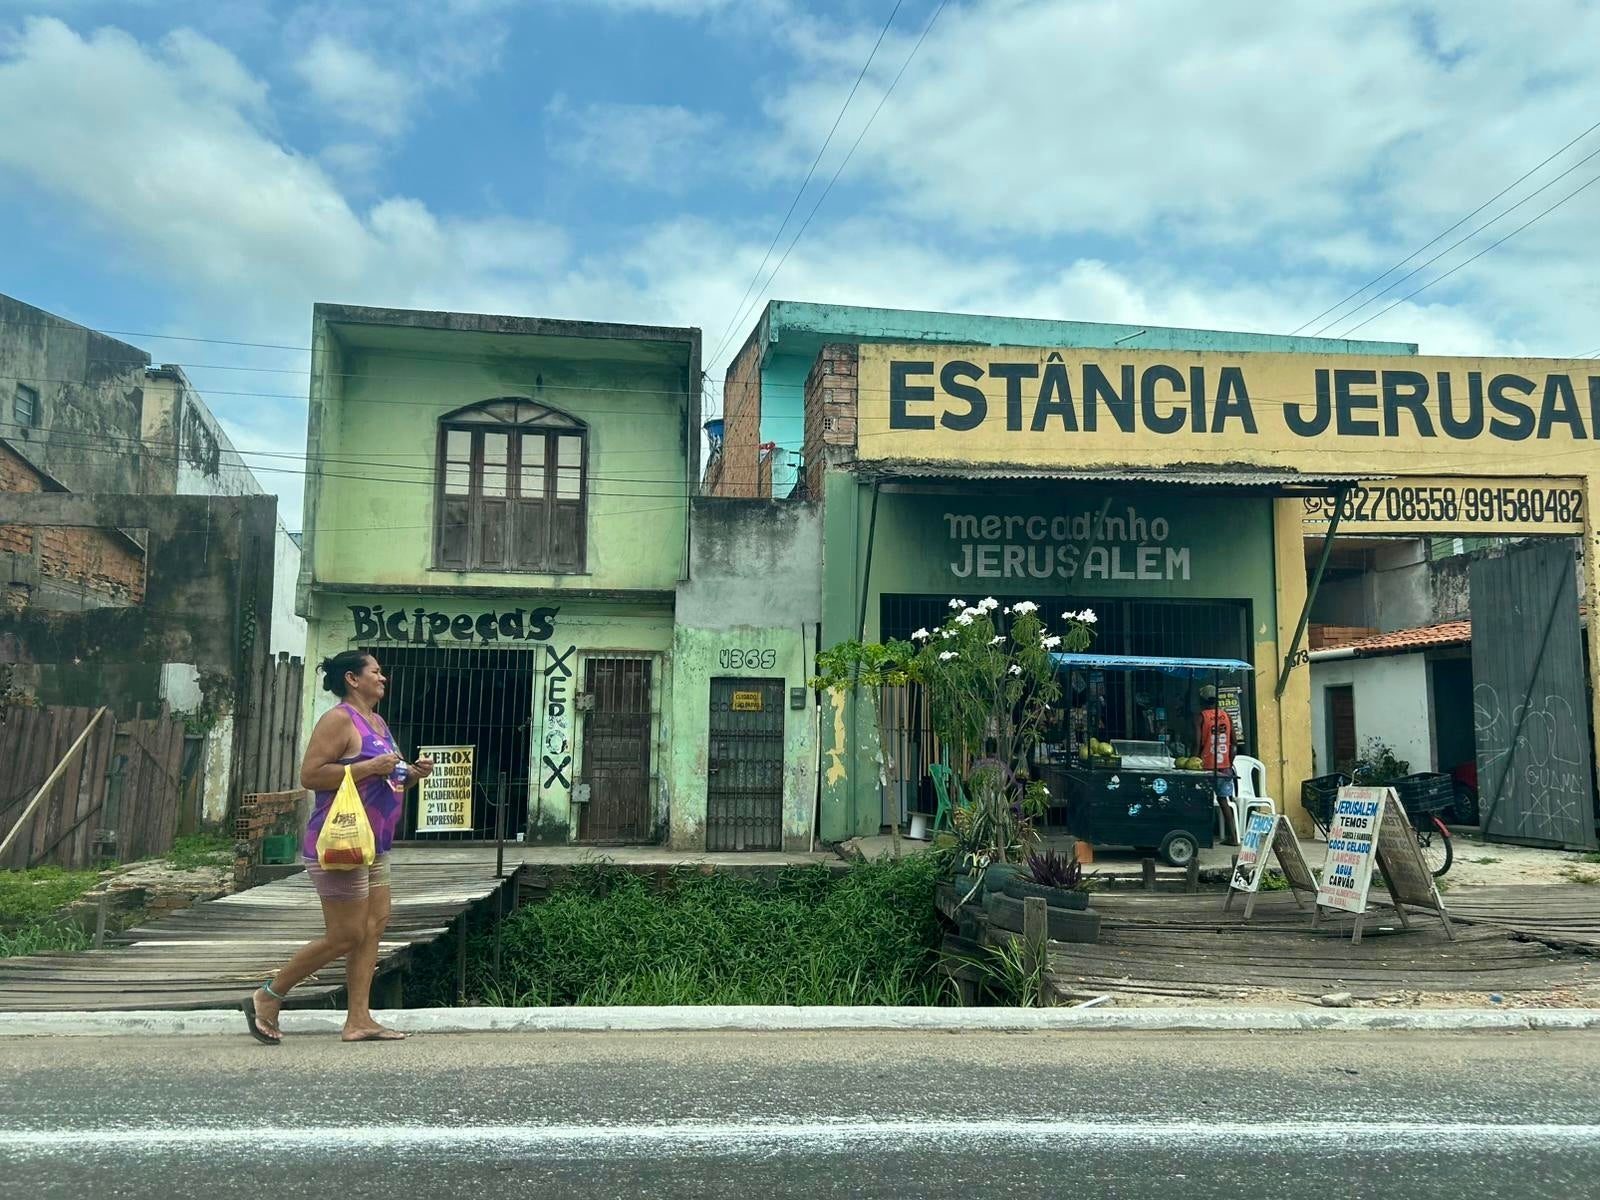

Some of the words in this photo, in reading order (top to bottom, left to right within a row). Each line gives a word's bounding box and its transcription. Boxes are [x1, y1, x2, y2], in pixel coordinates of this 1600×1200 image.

[889, 351, 1258, 434] ESTÂNCIA
[943, 506, 1169, 541] mercadinho
[950, 541, 1191, 580] JERUSALÉM
[346, 605, 561, 648] Bicipeças
[719, 648, 776, 669] 4365
[543, 645, 576, 789] XEROX
[444, 766, 471, 777] BOLETOS
[423, 776, 471, 789] PLASTIFICAÇÃO
[423, 788, 471, 800] ENCADERNAÇÃO
[437, 803, 447, 813] VIA
[1334, 800, 1379, 816] JERUSALEM
[426, 813, 464, 825] IMPRESSÕES
[1340, 816, 1368, 828] TEMOS
[1328, 839, 1345, 850] COCO
[1328, 875, 1355, 889] CARVÃO
